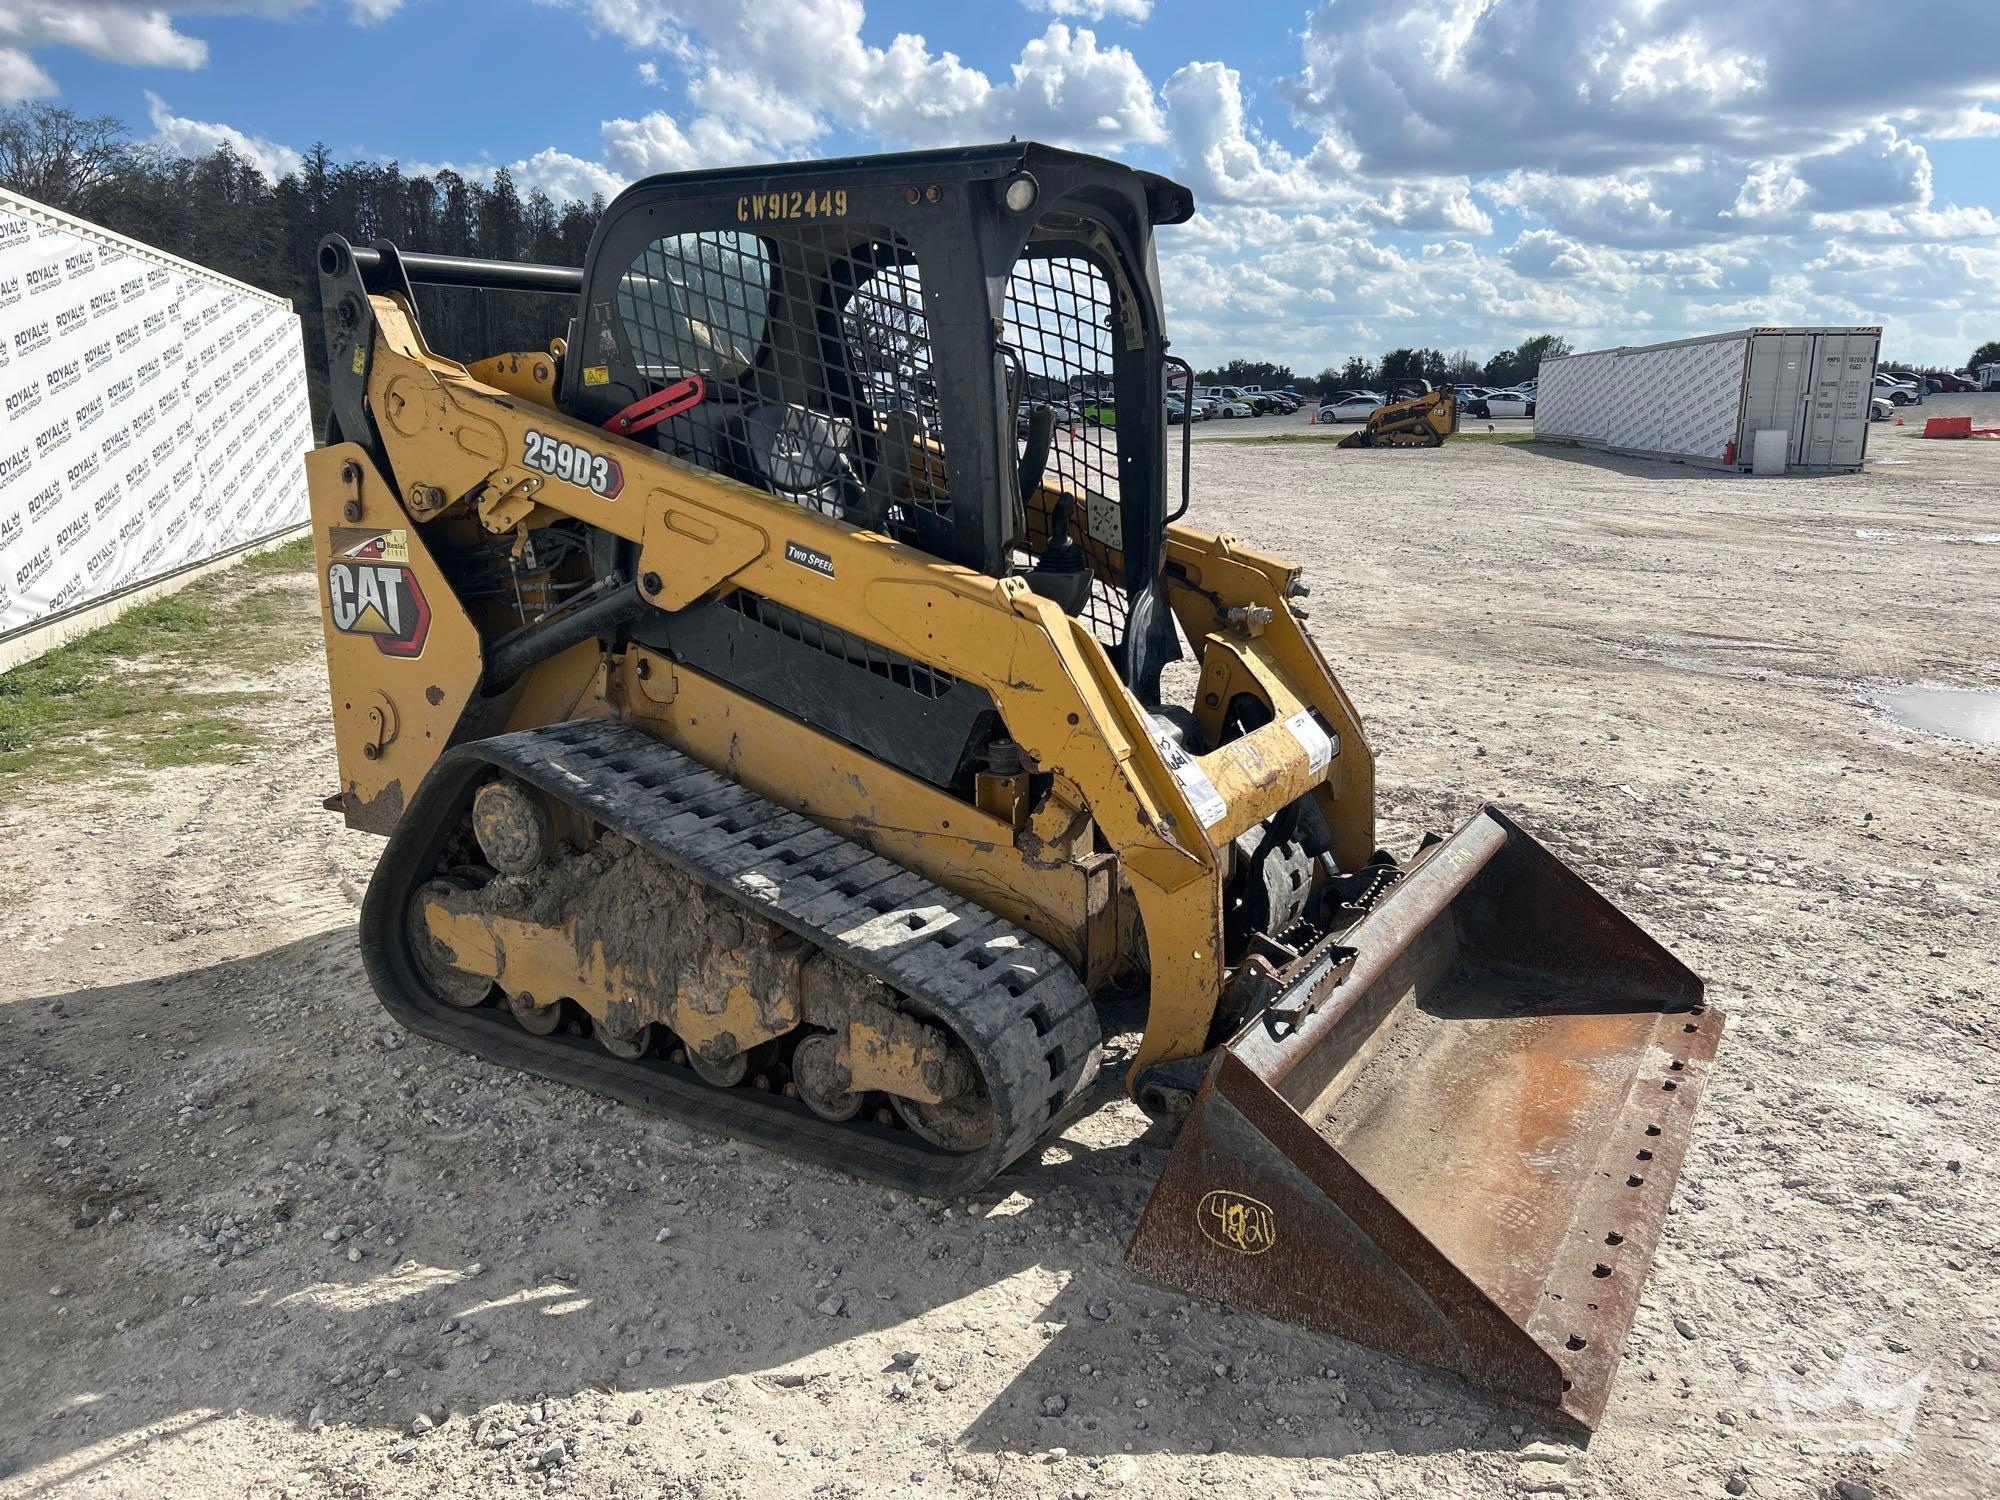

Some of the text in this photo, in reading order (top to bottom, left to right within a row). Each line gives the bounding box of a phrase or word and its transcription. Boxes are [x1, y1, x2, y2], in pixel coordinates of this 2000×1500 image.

[737, 190, 848, 222] CW912449
[0, 221, 21, 238] OYAL
[65, 253, 89, 270] ROYAL
[26, 266, 54, 285] ROYAL
[120, 279, 140, 295] ROYAL
[90, 292, 112, 310] ROYAL
[168, 301, 181, 315] ROY
[56, 308, 81, 327] ROYAL
[143, 313, 161, 329] ROYAL
[14, 325, 43, 347] ROYAL
[116, 327, 136, 345] ROYAL
[83, 344, 106, 364] ROYAL
[48, 364, 74, 386] ROYAL
[137, 361, 155, 379] ROYAL
[5, 386, 35, 411] ROYAL
[108, 379, 129, 399] ROYAL
[75, 400, 99, 422] ROYAL
[35, 424, 63, 449] ROYAL
[102, 432, 123, 454] ROYAL
[0, 451, 23, 476] OYAL
[69, 457, 93, 481] ROYAL
[524, 431, 609, 494] 259D3
[27, 486, 56, 514] ROYAL
[94, 488, 116, 513] ROYAL
[57, 519, 82, 546] ROYAL
[386, 541, 406, 550] Rental
[16, 554, 45, 584] ROYAL
[88, 546, 110, 573] ROYAL
[788, 546, 834, 573] TWO SPEED
[49, 581, 77, 612] ROYAL
[329, 563, 403, 635] CAT
